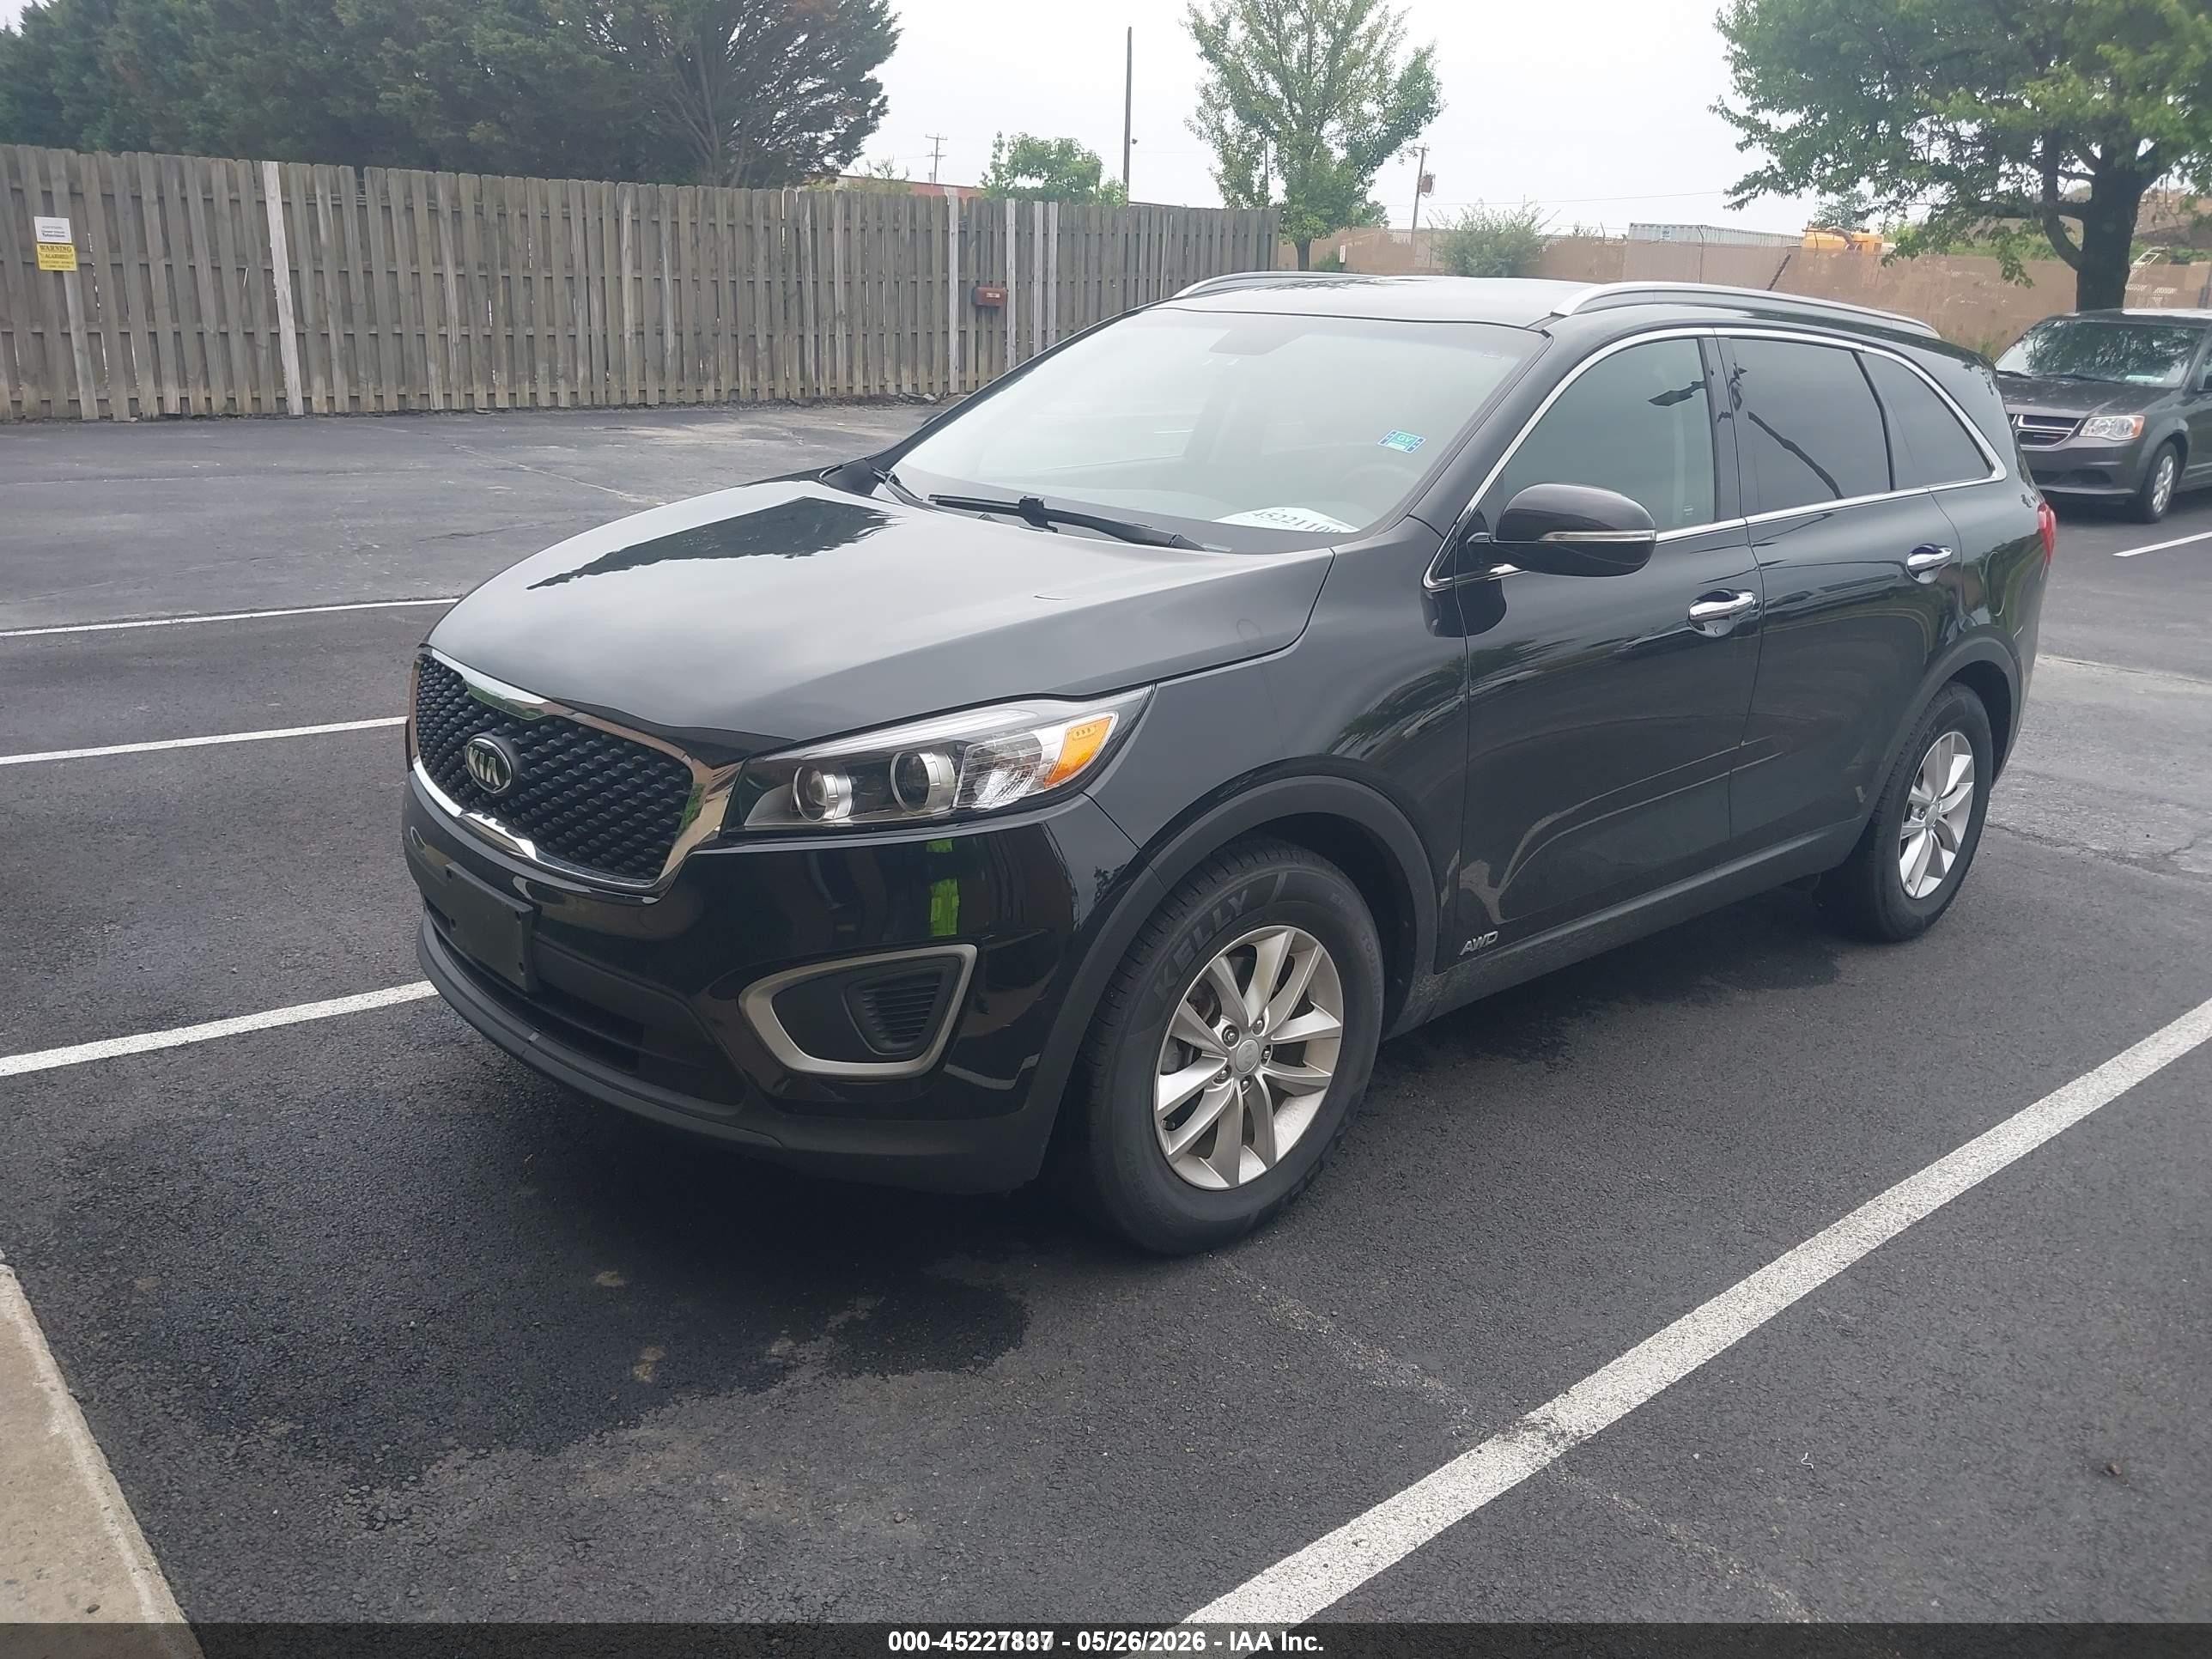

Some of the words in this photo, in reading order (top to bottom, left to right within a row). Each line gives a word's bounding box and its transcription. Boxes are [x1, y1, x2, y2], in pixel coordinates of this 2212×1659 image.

[468, 746, 501, 787] KIA
[1153, 890, 1248, 1000] KELLY
[1460, 931, 1498, 955] AWD
